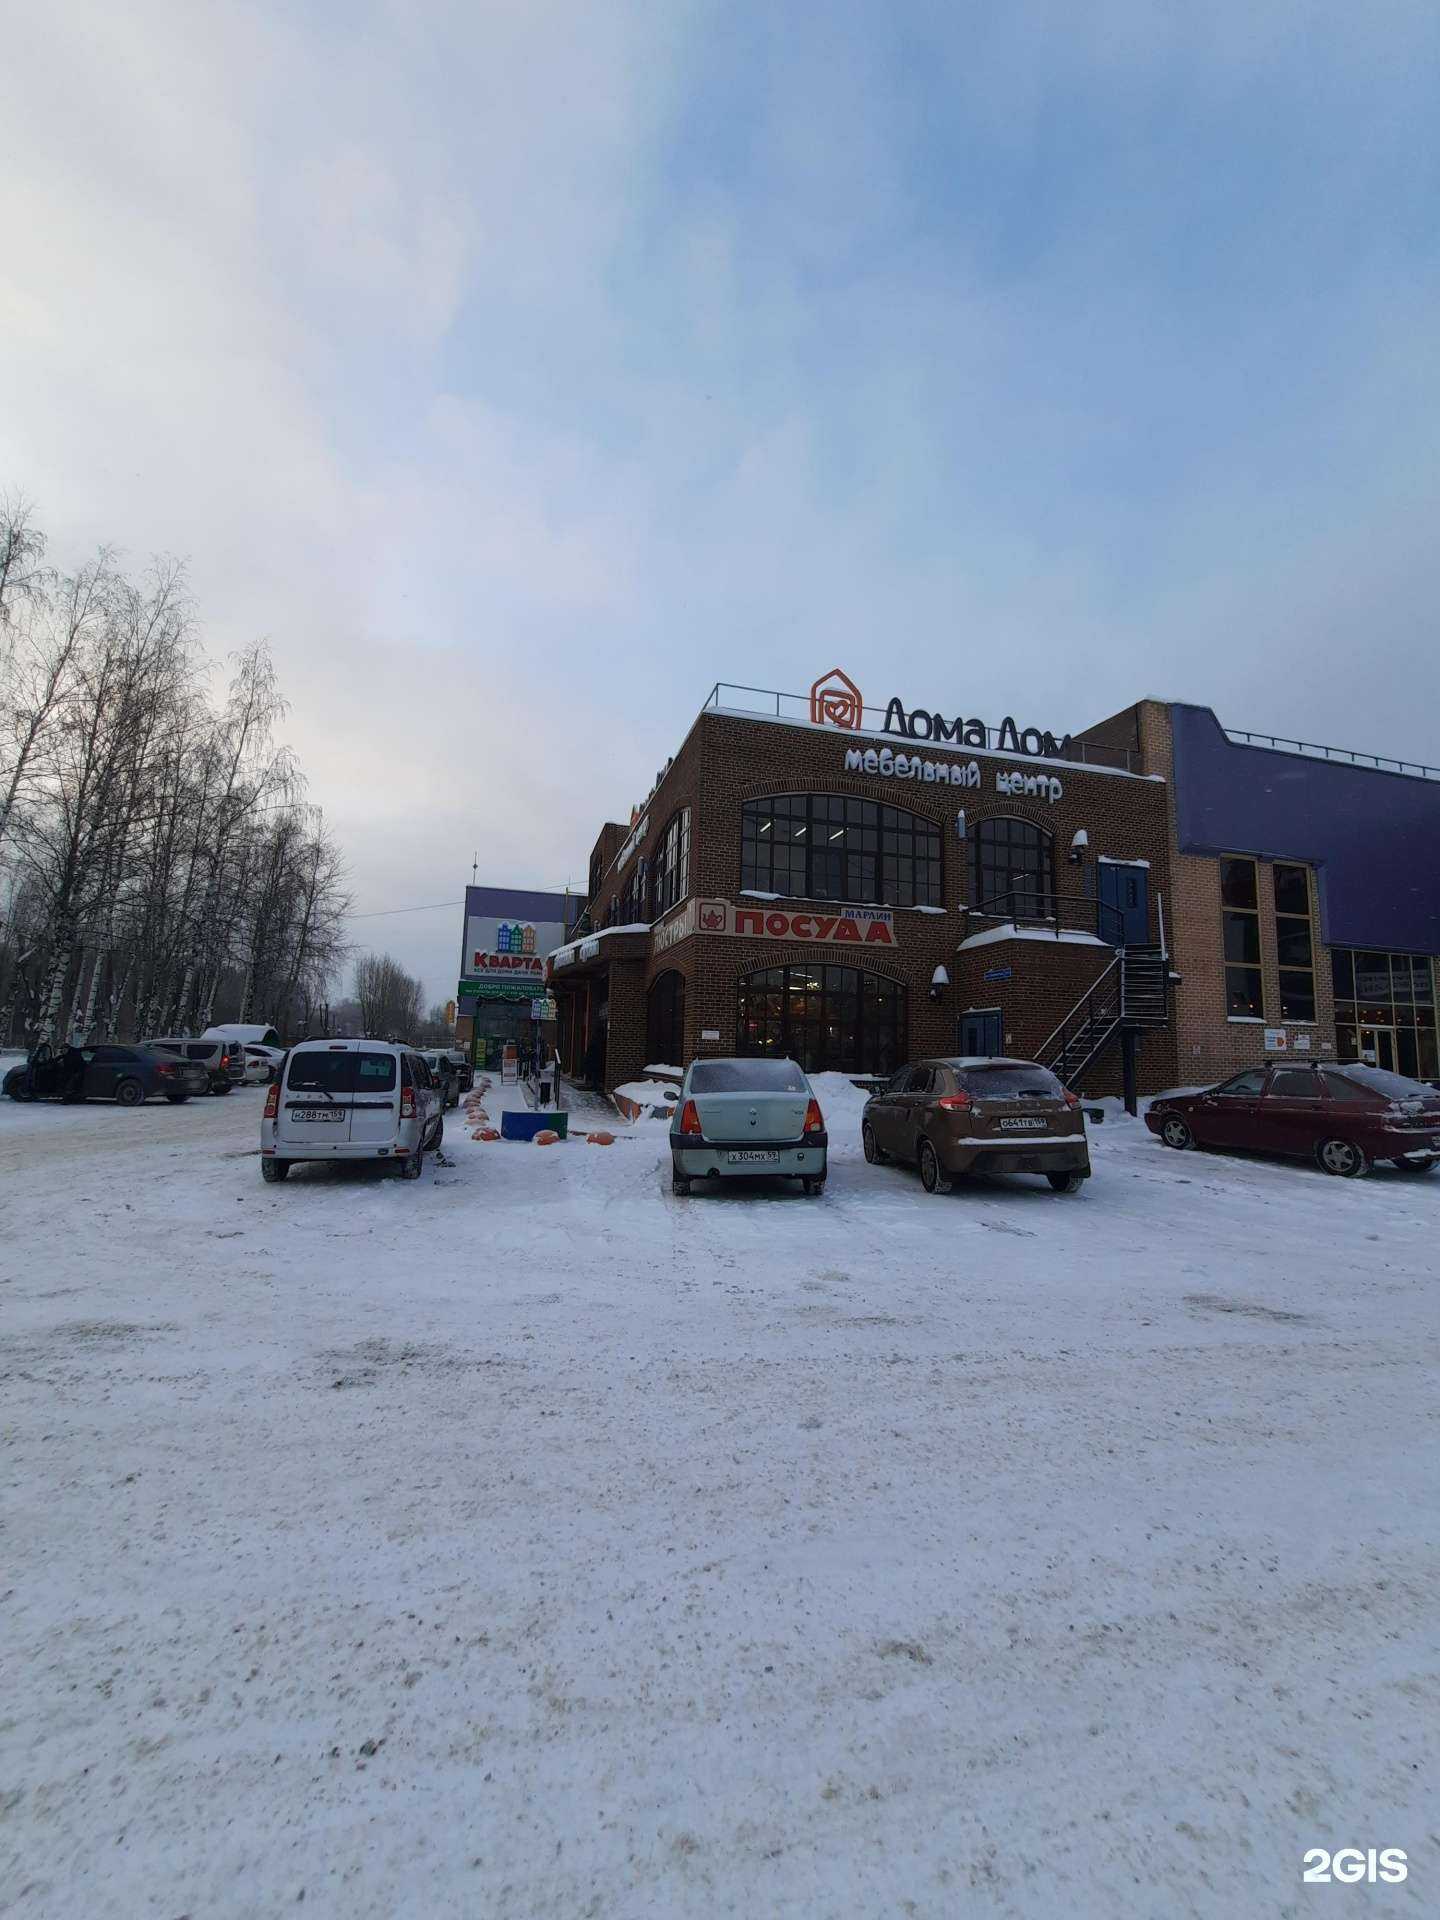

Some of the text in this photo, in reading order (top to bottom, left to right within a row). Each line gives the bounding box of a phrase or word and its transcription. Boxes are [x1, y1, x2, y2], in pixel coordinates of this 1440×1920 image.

[880, 696, 1073, 761] Дома Дом
[844, 747, 1064, 804] мебельный центр
[735, 910, 893, 944] ПОСУДА
